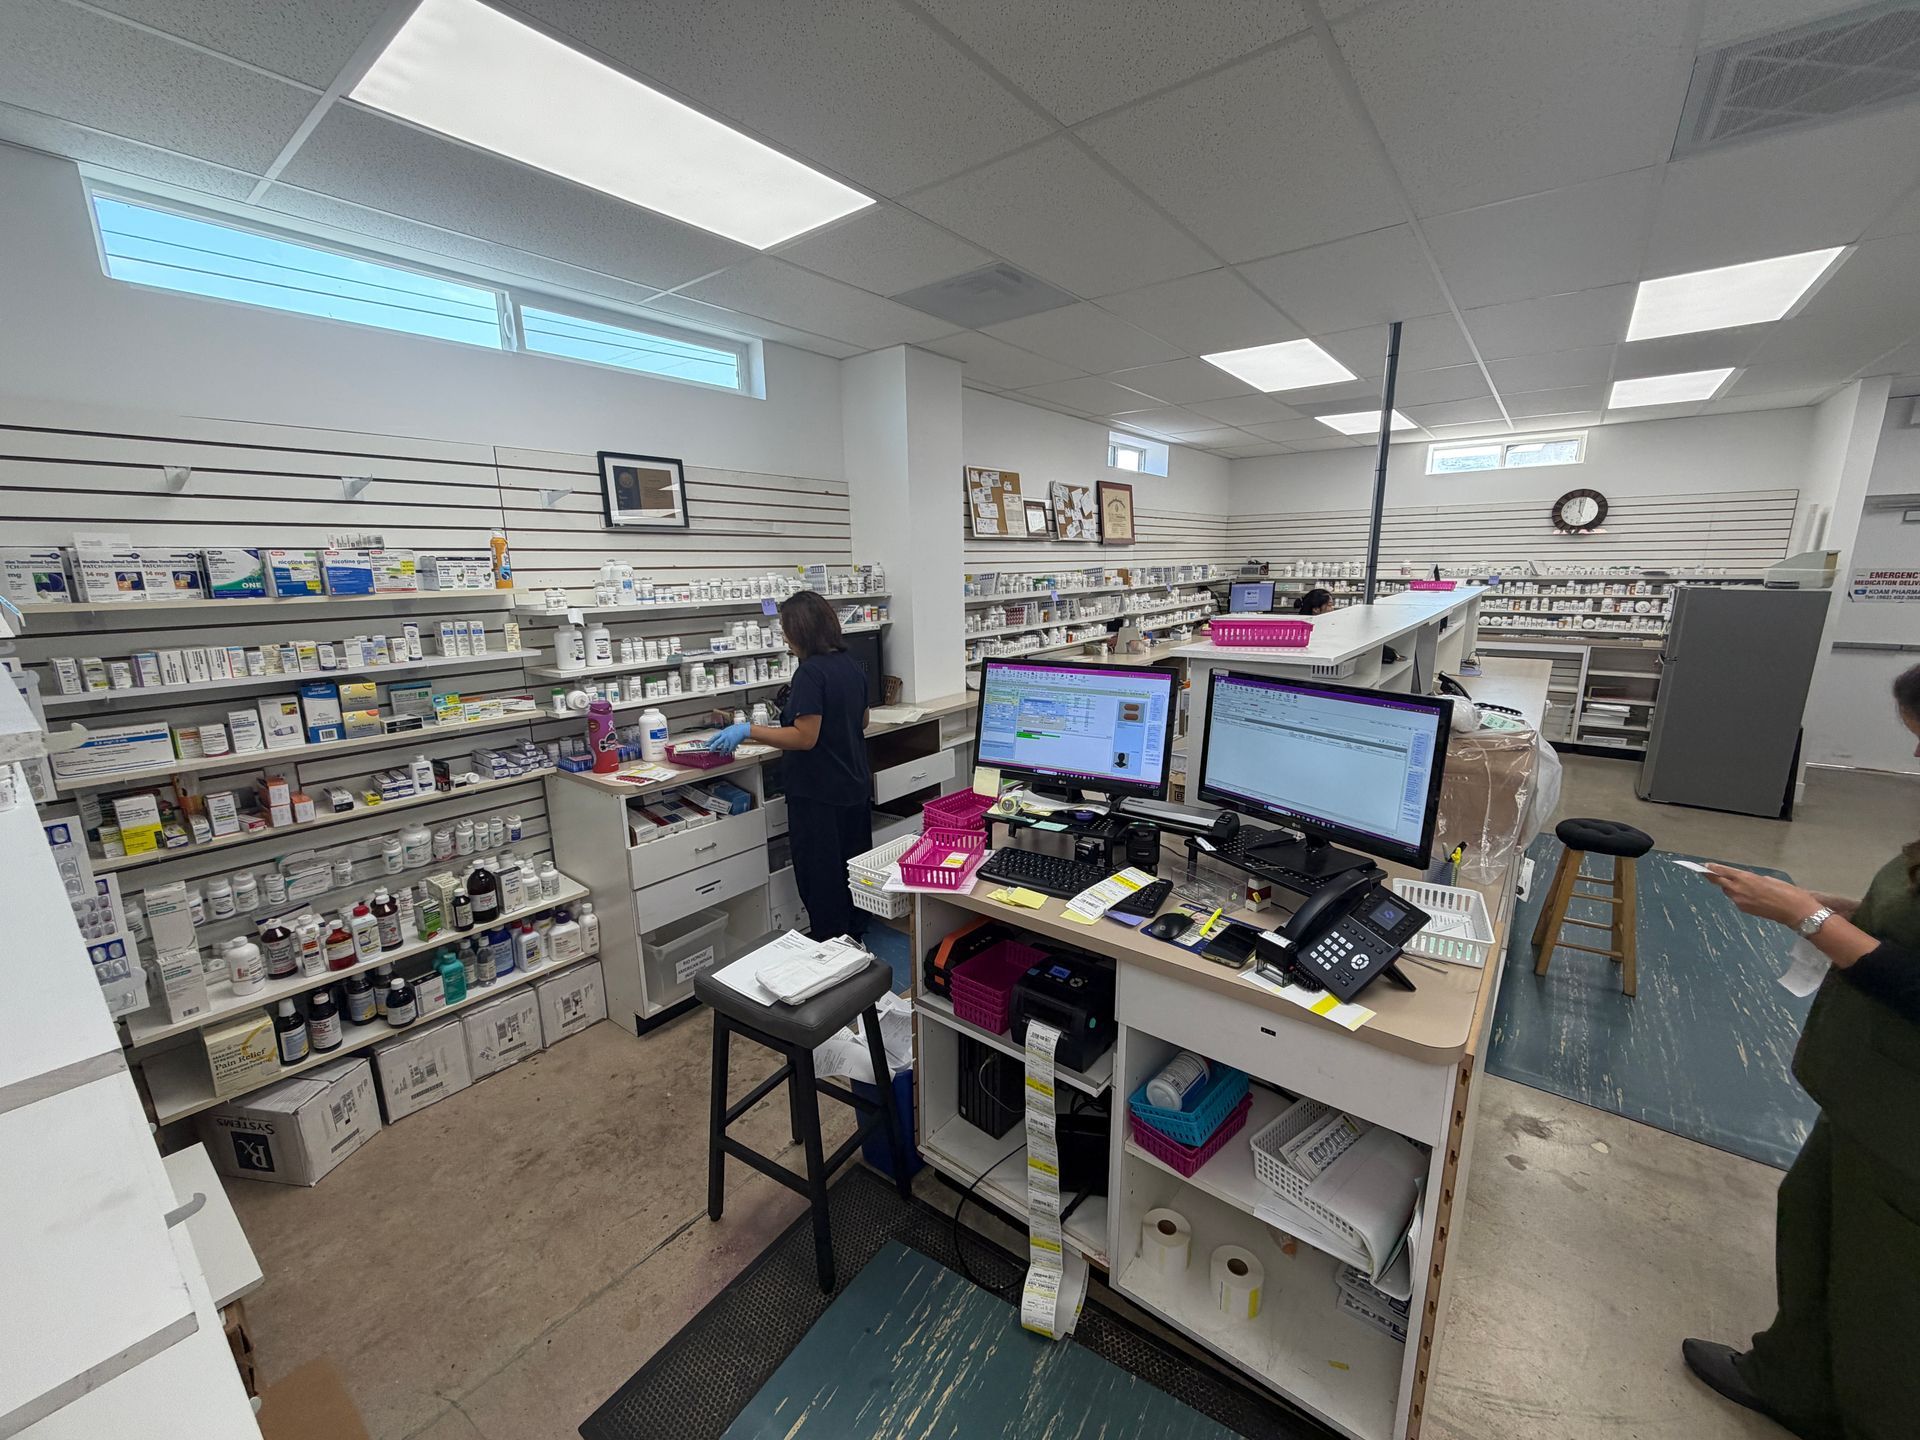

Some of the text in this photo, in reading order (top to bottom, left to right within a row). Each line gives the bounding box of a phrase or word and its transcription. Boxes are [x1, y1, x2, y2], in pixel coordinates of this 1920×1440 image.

[215, 1048, 266, 1070] Pain Relief
[216, 1118, 275, 1134] SYSTEMS
